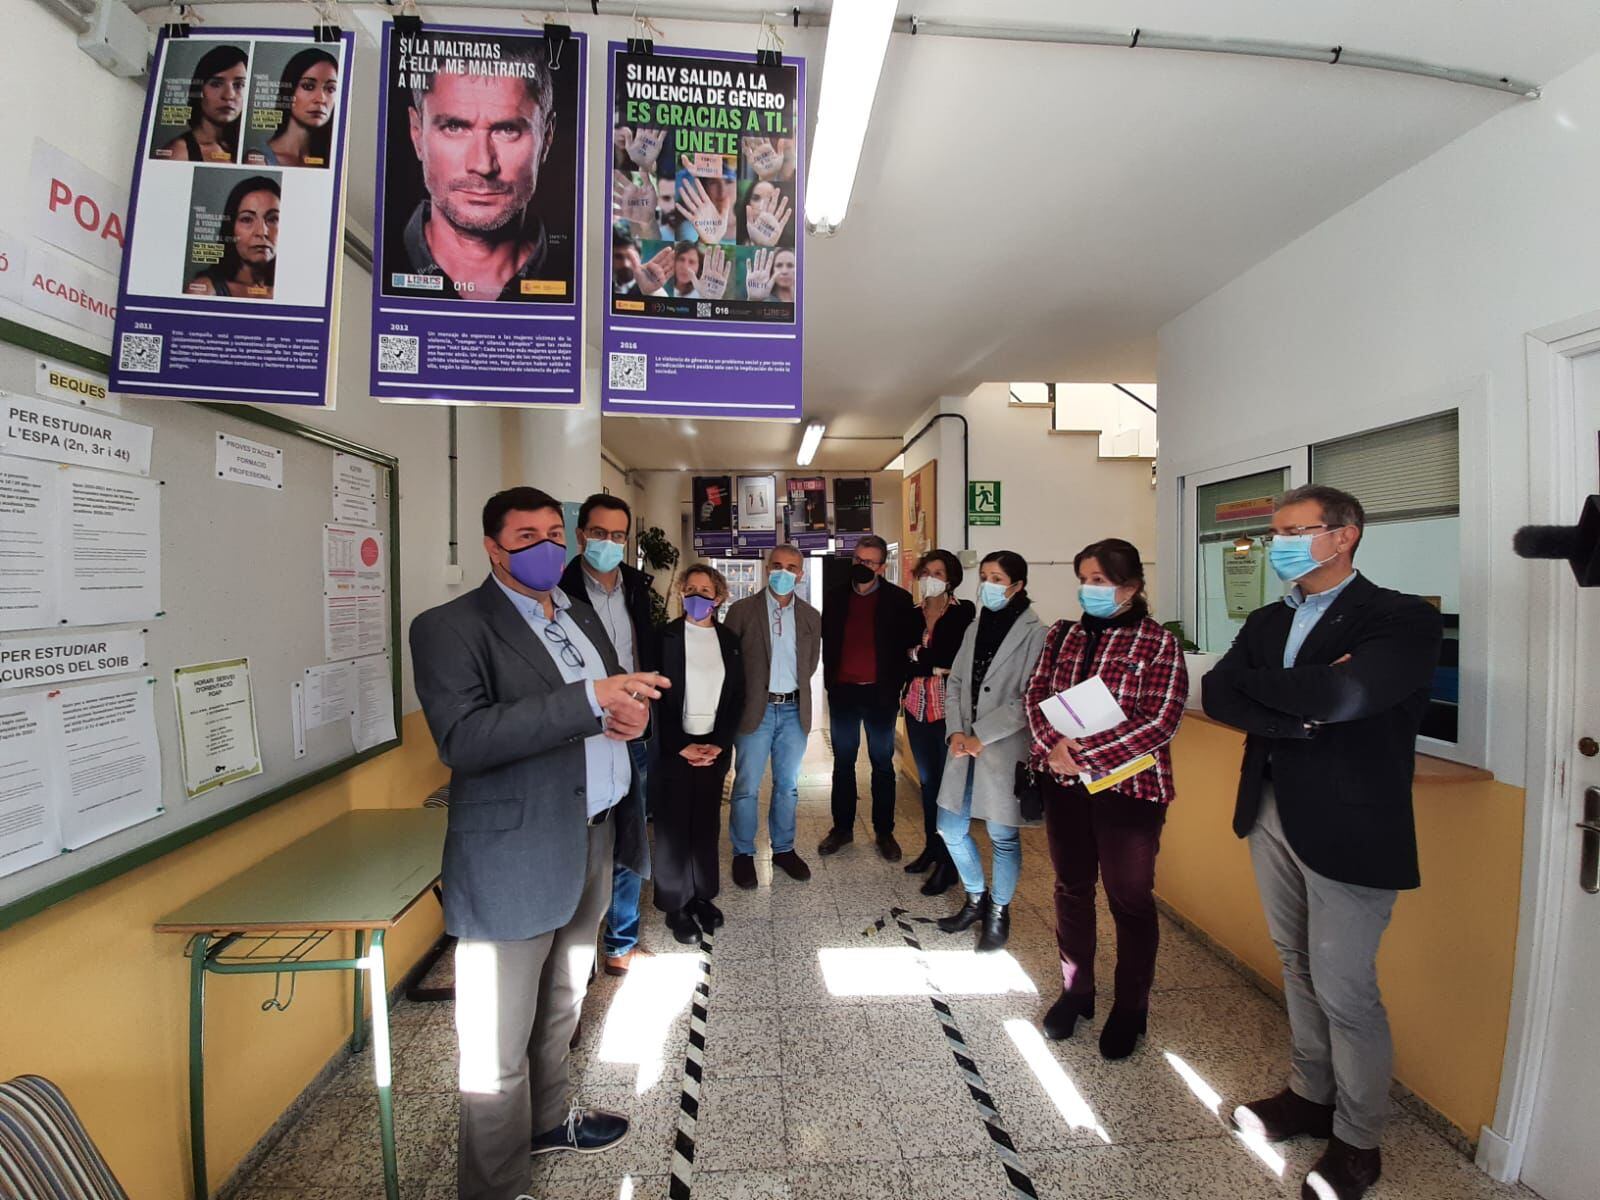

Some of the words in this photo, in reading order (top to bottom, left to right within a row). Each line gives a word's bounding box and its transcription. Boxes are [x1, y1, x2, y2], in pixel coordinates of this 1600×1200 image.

[400, 38, 412, 54] SI
[416, 39, 430, 55] LA
[434, 40, 500, 58] MALTRATAS
[398, 56, 406, 71] A
[446, 58, 464, 74] ME
[469, 60, 536, 78] MALTRATAS
[398, 72, 406, 88] A
[627, 64, 641, 80] SI
[646, 65, 676, 83] HAY
[680, 68, 732, 87] SALIDA
[736, 72, 746, 89] A
[750, 74, 767, 90] LA
[626, 82, 703, 104] VIOLENCIA
[707, 89, 725, 105] DE
[729, 90, 785, 109] GÉNERO
[626, 101, 650, 123] ES
[656, 104, 741, 130] GRACIAS
[746, 110, 760, 131] A
[765, 111, 787, 133] TI.
[675, 129, 738, 154] ÚNETE
[454, 281, 475, 292] 016
[50, 373, 106, 399] BEQUES
[10, 407, 38, 424] PER
[42, 415, 112, 441] ESTUDIAR
[8, 426, 60, 447] L'ESPA
[64, 438, 88, 454] (2n,
[92, 443, 105, 455] 3r
[108, 445, 111, 457] i
[114, 448, 130, 462] 4t)
[1, 649, 31, 663] PER
[35, 642, 107, 659] ESTUDIAR
[1, 664, 65, 682] CURSOS
[68, 660, 94, 674] DEL
[98, 656, 129, 669] SOIB
